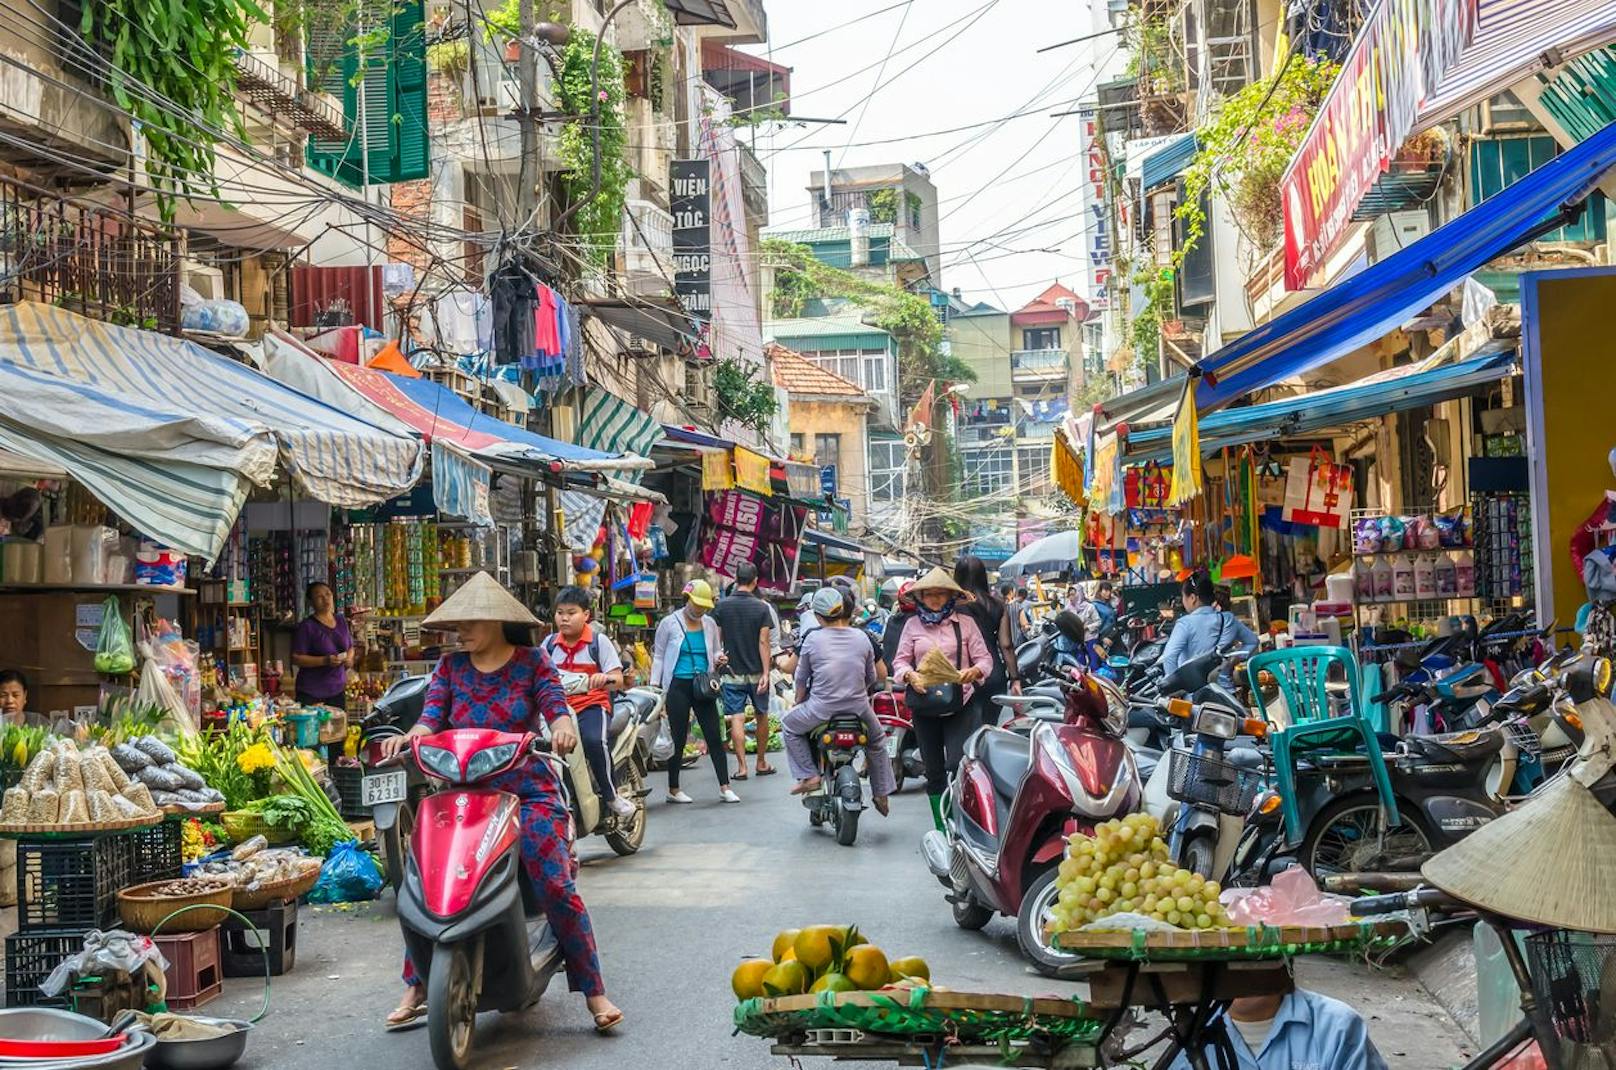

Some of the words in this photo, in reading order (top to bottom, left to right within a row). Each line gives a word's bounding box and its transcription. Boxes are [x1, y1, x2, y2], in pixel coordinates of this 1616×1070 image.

[674, 173, 706, 199] VIỆN
[675, 206, 703, 227] TÓC
[1091, 205, 1112, 266] VIEW
[673, 255, 709, 277] NGỌC
[368, 787, 400, 803] 6239
